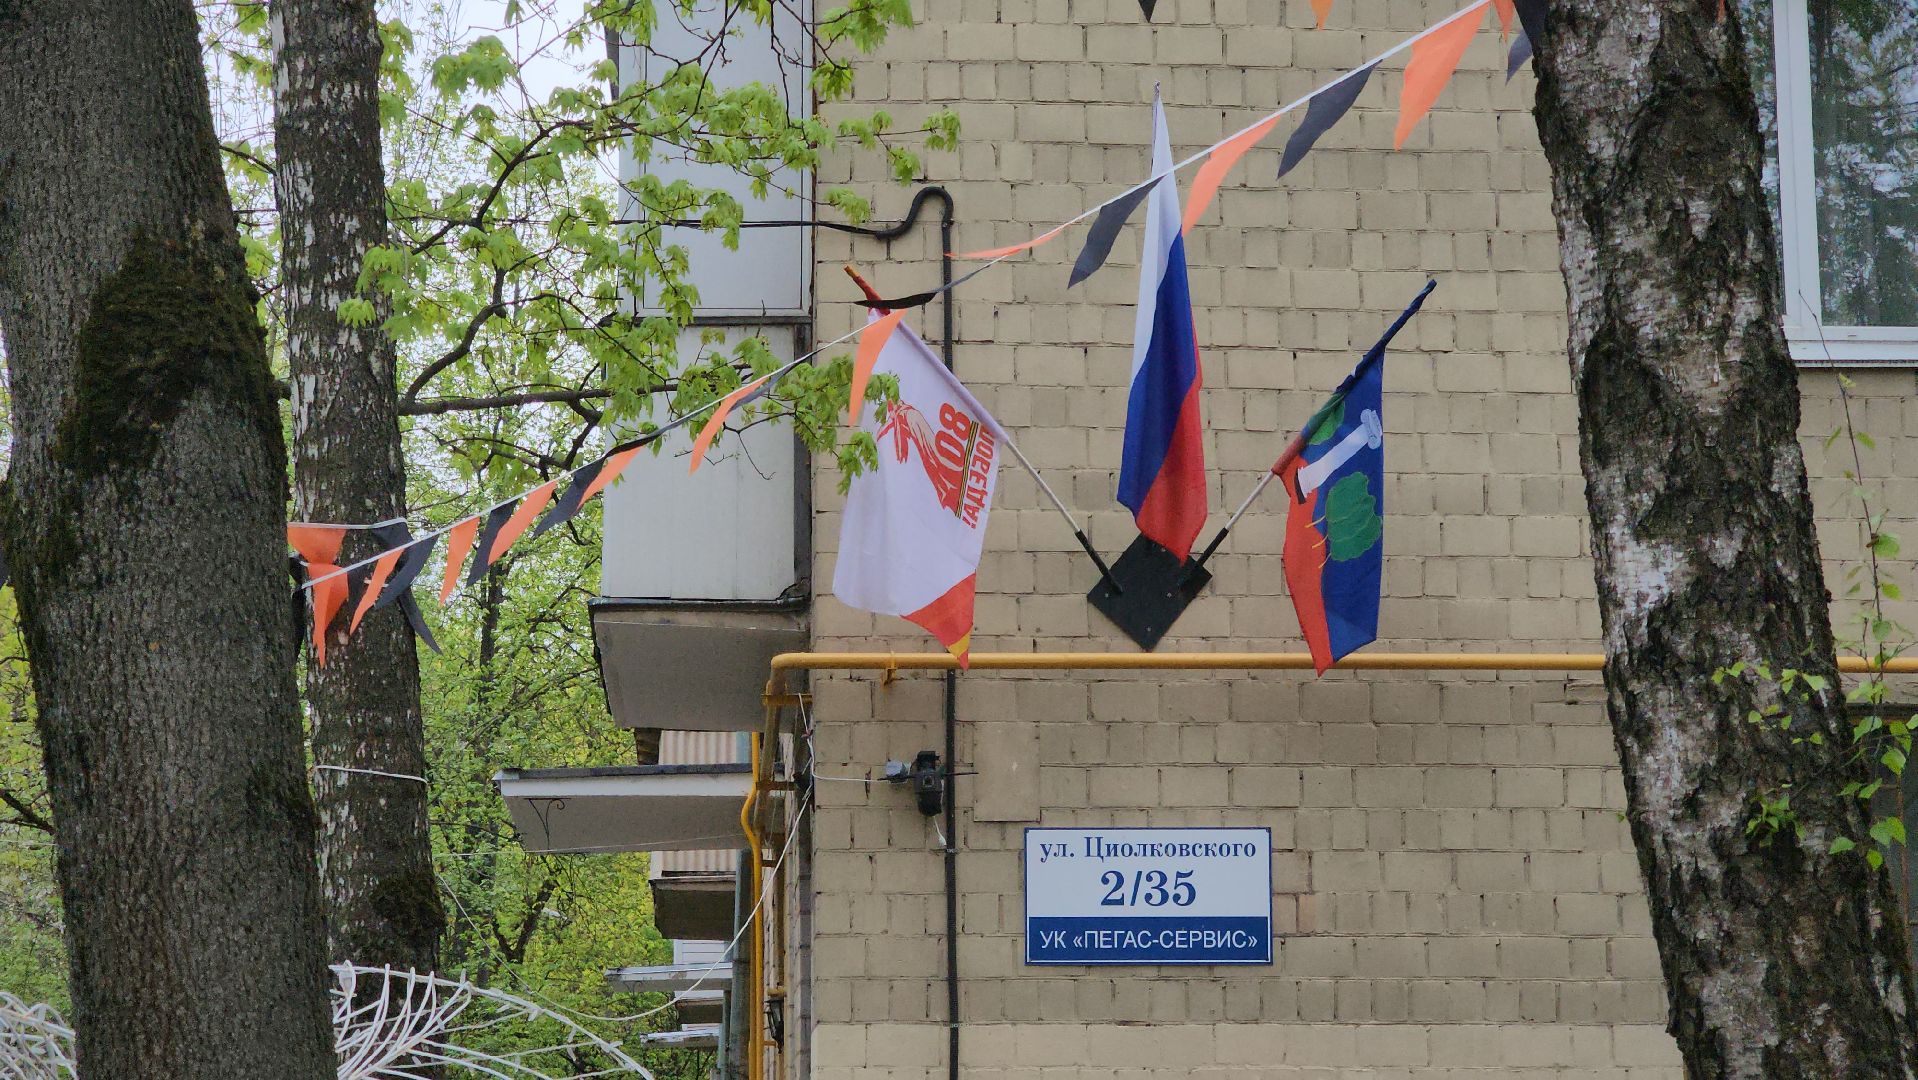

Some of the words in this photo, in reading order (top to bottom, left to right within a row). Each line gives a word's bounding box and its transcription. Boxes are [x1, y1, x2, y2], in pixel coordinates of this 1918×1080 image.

[1039, 842, 1075, 863] ул.
[1083, 836, 1257, 863] Циолковского
[1100, 869, 1197, 907] 2/35
[1039, 930, 1067, 949] УК
[1072, 929, 1258, 949] «ПЕГАС-СЕРВИС»
